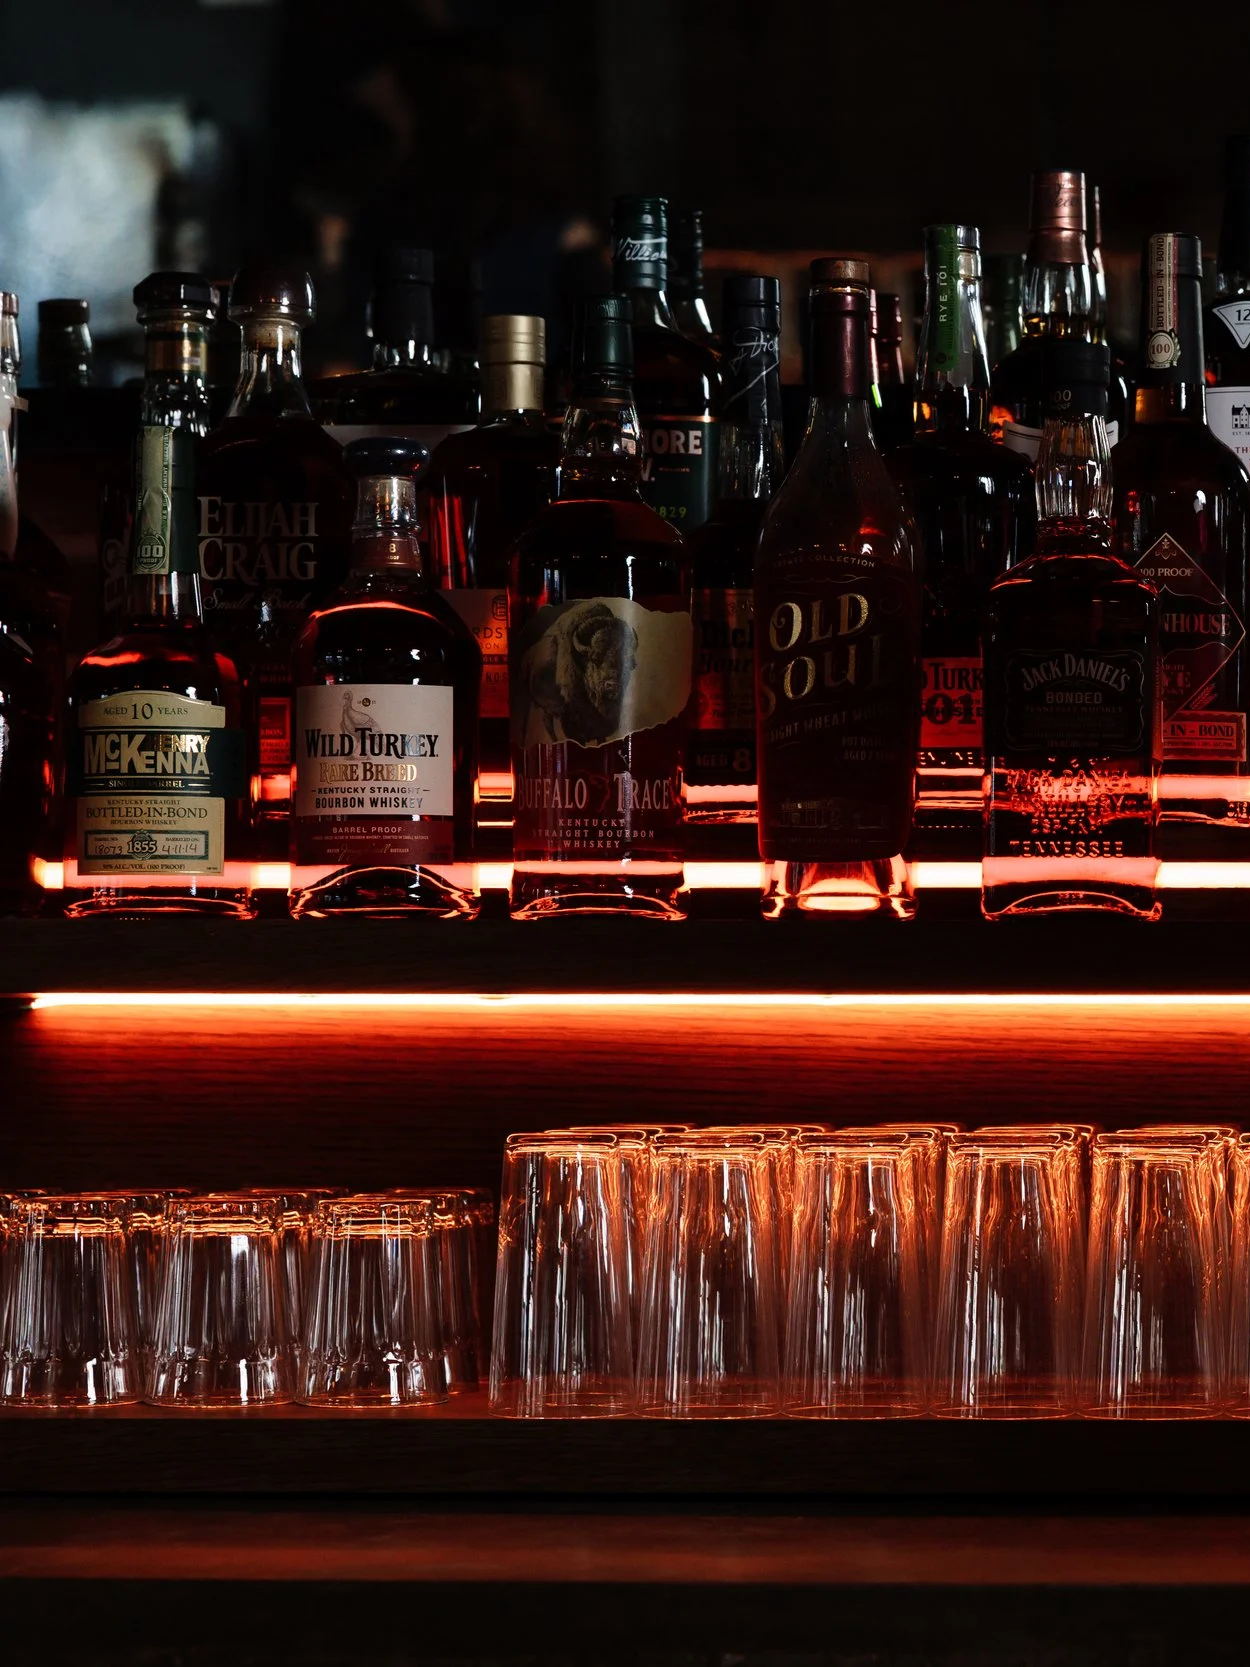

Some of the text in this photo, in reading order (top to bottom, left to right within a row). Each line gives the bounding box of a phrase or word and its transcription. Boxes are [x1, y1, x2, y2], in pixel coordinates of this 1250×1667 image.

[939, 294, 948, 323] RYE
[1151, 342, 1171, 355] 100
[197, 495, 320, 543] ELIJAH
[136, 545, 164, 557] 100
[198, 537, 319, 586] CRAIG
[808, 554, 876, 568] COLLECTION
[1157, 567, 1195, 577] PROOF
[768, 592, 872, 652] OLD
[758, 631, 894, 722] SOUL
[1021, 653, 1131, 692] JACK DANIEL'S
[1045, 691, 1104, 705] BONDED
[104, 703, 189, 720] AGED 10 YEARS
[804, 710, 849, 734] WHEAT
[1198, 723, 1234, 737] BOND
[304, 728, 354, 758] WILD
[695, 748, 753, 772] AGED 8
[319, 761, 417, 784] RARE BREED
[317, 786, 421, 794] KENTUCKY STRAIGHT
[518, 771, 671, 814] BUFFALO TRACE
[315, 796, 423, 809] BOURBON WHISKEY
[86, 806, 208, 819] BOTTLED-IN-BOND
[558, 818, 626, 827] KENTUCKY
[332, 826, 403, 834] BARREL PROOF
[531, 829, 655, 838] STRAIGHT BOURBON
[127, 840, 157, 853] 1855
[563, 840, 620, 849] WHISKEY
[1009, 840, 1125, 858] TENNESSEE
